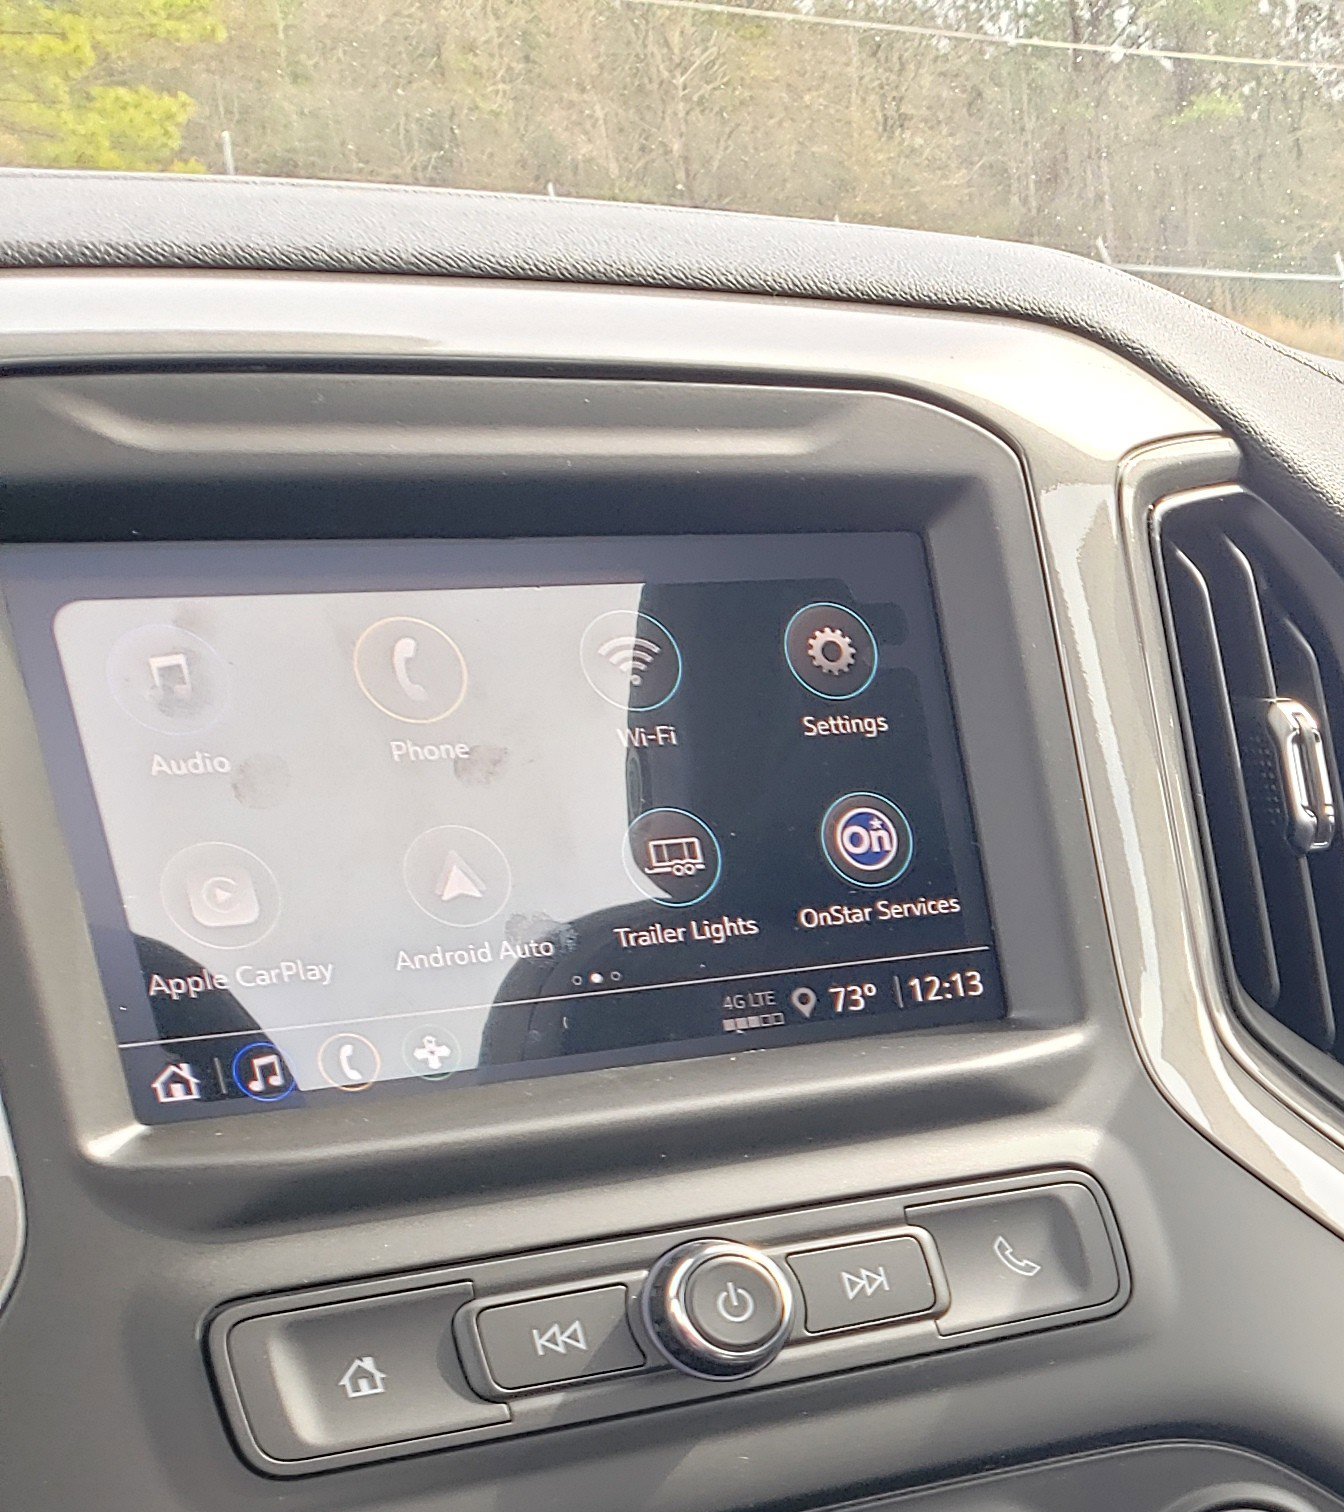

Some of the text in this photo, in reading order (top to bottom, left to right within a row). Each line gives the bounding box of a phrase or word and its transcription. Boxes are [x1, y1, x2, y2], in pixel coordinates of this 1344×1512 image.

[616, 725, 677, 748] Wi-Fi
[803, 715, 888, 738] Settings
[150, 753, 231, 777] Audio
[390, 741, 470, 762] Phone
[801, 896, 961, 928] OnStar Services
[613, 916, 759, 948] Trailer Lights
[396, 938, 555, 972] Android Auto
[149, 959, 334, 1001] Apple CarPlay
[908, 970, 985, 1002] 12:13
[722, 990, 777, 1010] 4G LTE
